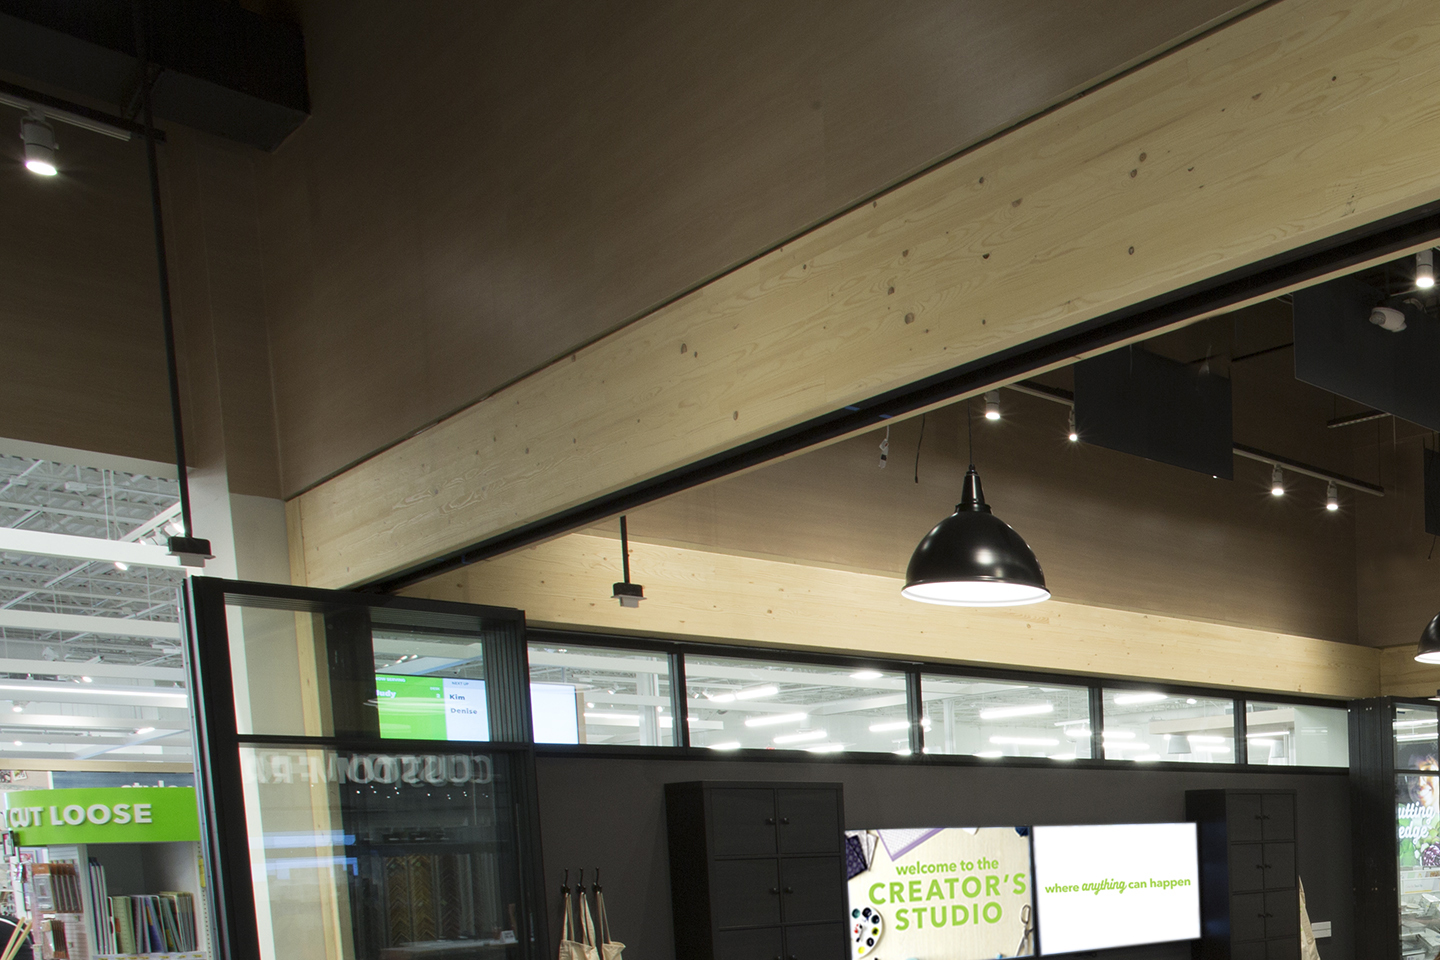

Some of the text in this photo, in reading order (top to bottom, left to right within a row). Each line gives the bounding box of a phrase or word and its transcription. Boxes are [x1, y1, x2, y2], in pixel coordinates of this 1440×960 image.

[449, 693, 466, 701] Kim
[450, 707, 478, 715] Denise
[10, 803, 153, 828] CUT LOOSE
[1398, 801, 1436, 825] utting
[1398, 824, 1430, 844] edge
[895, 857, 999, 876] welcome to the
[868, 873, 1026, 905] CREATOR'S
[1045, 876, 1192, 896] where anything can happen
[895, 901, 1003, 931] STUDIO
